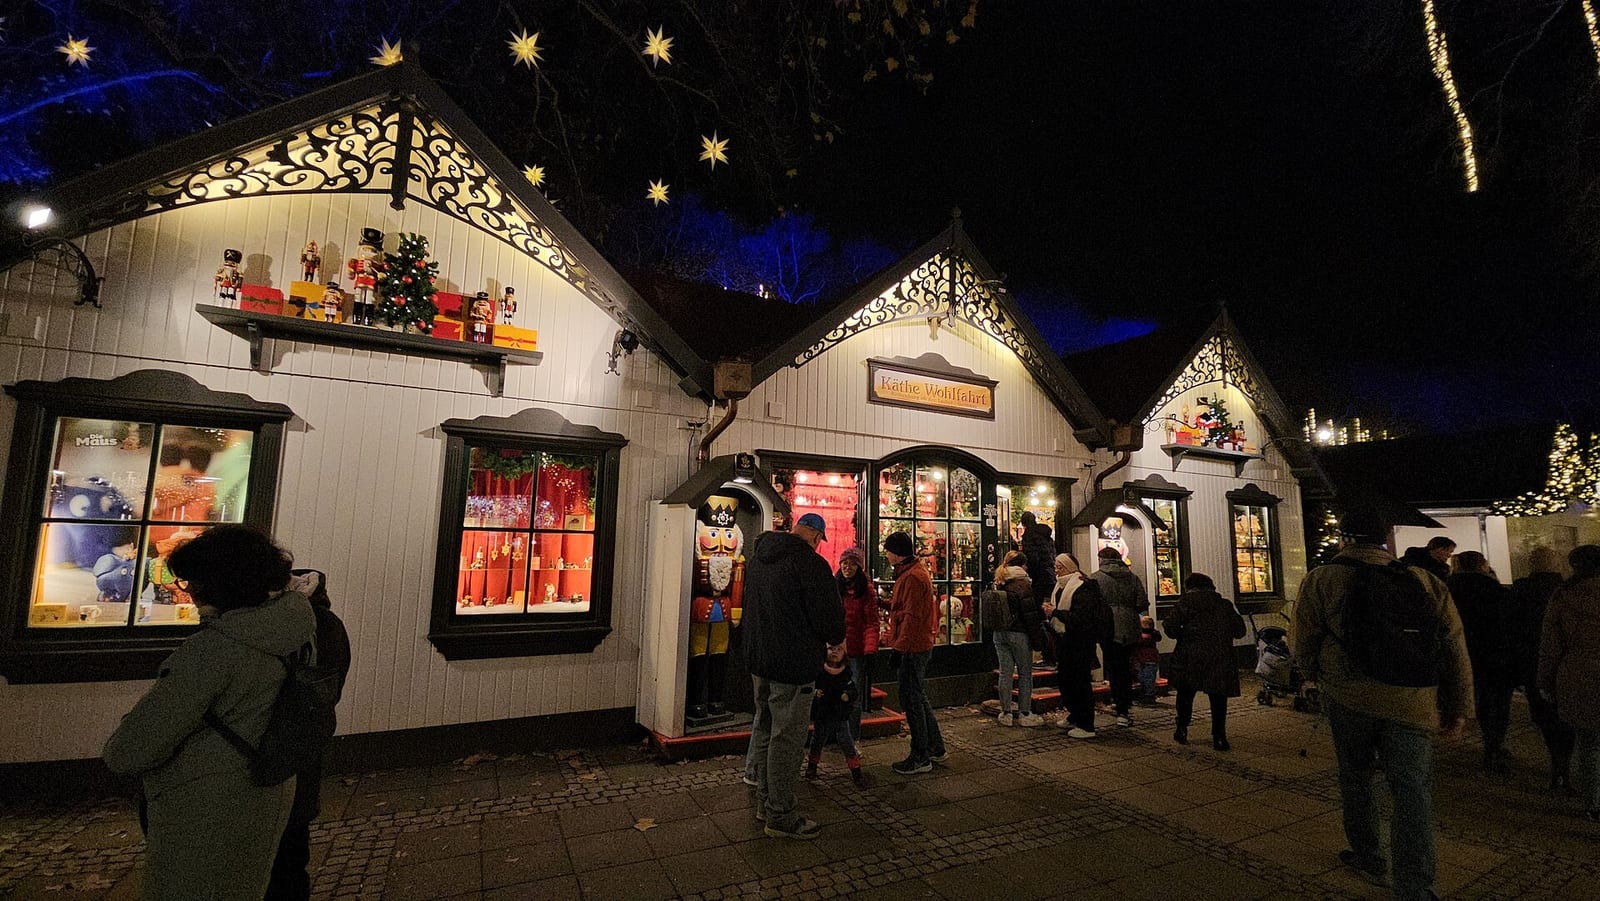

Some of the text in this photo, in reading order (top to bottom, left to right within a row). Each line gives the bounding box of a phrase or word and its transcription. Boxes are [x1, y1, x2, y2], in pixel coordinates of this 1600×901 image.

[881, 376, 921, 394] Käthe
[924, 383, 987, 405] Wohlfahrt
[76, 437, 118, 447] Maus
